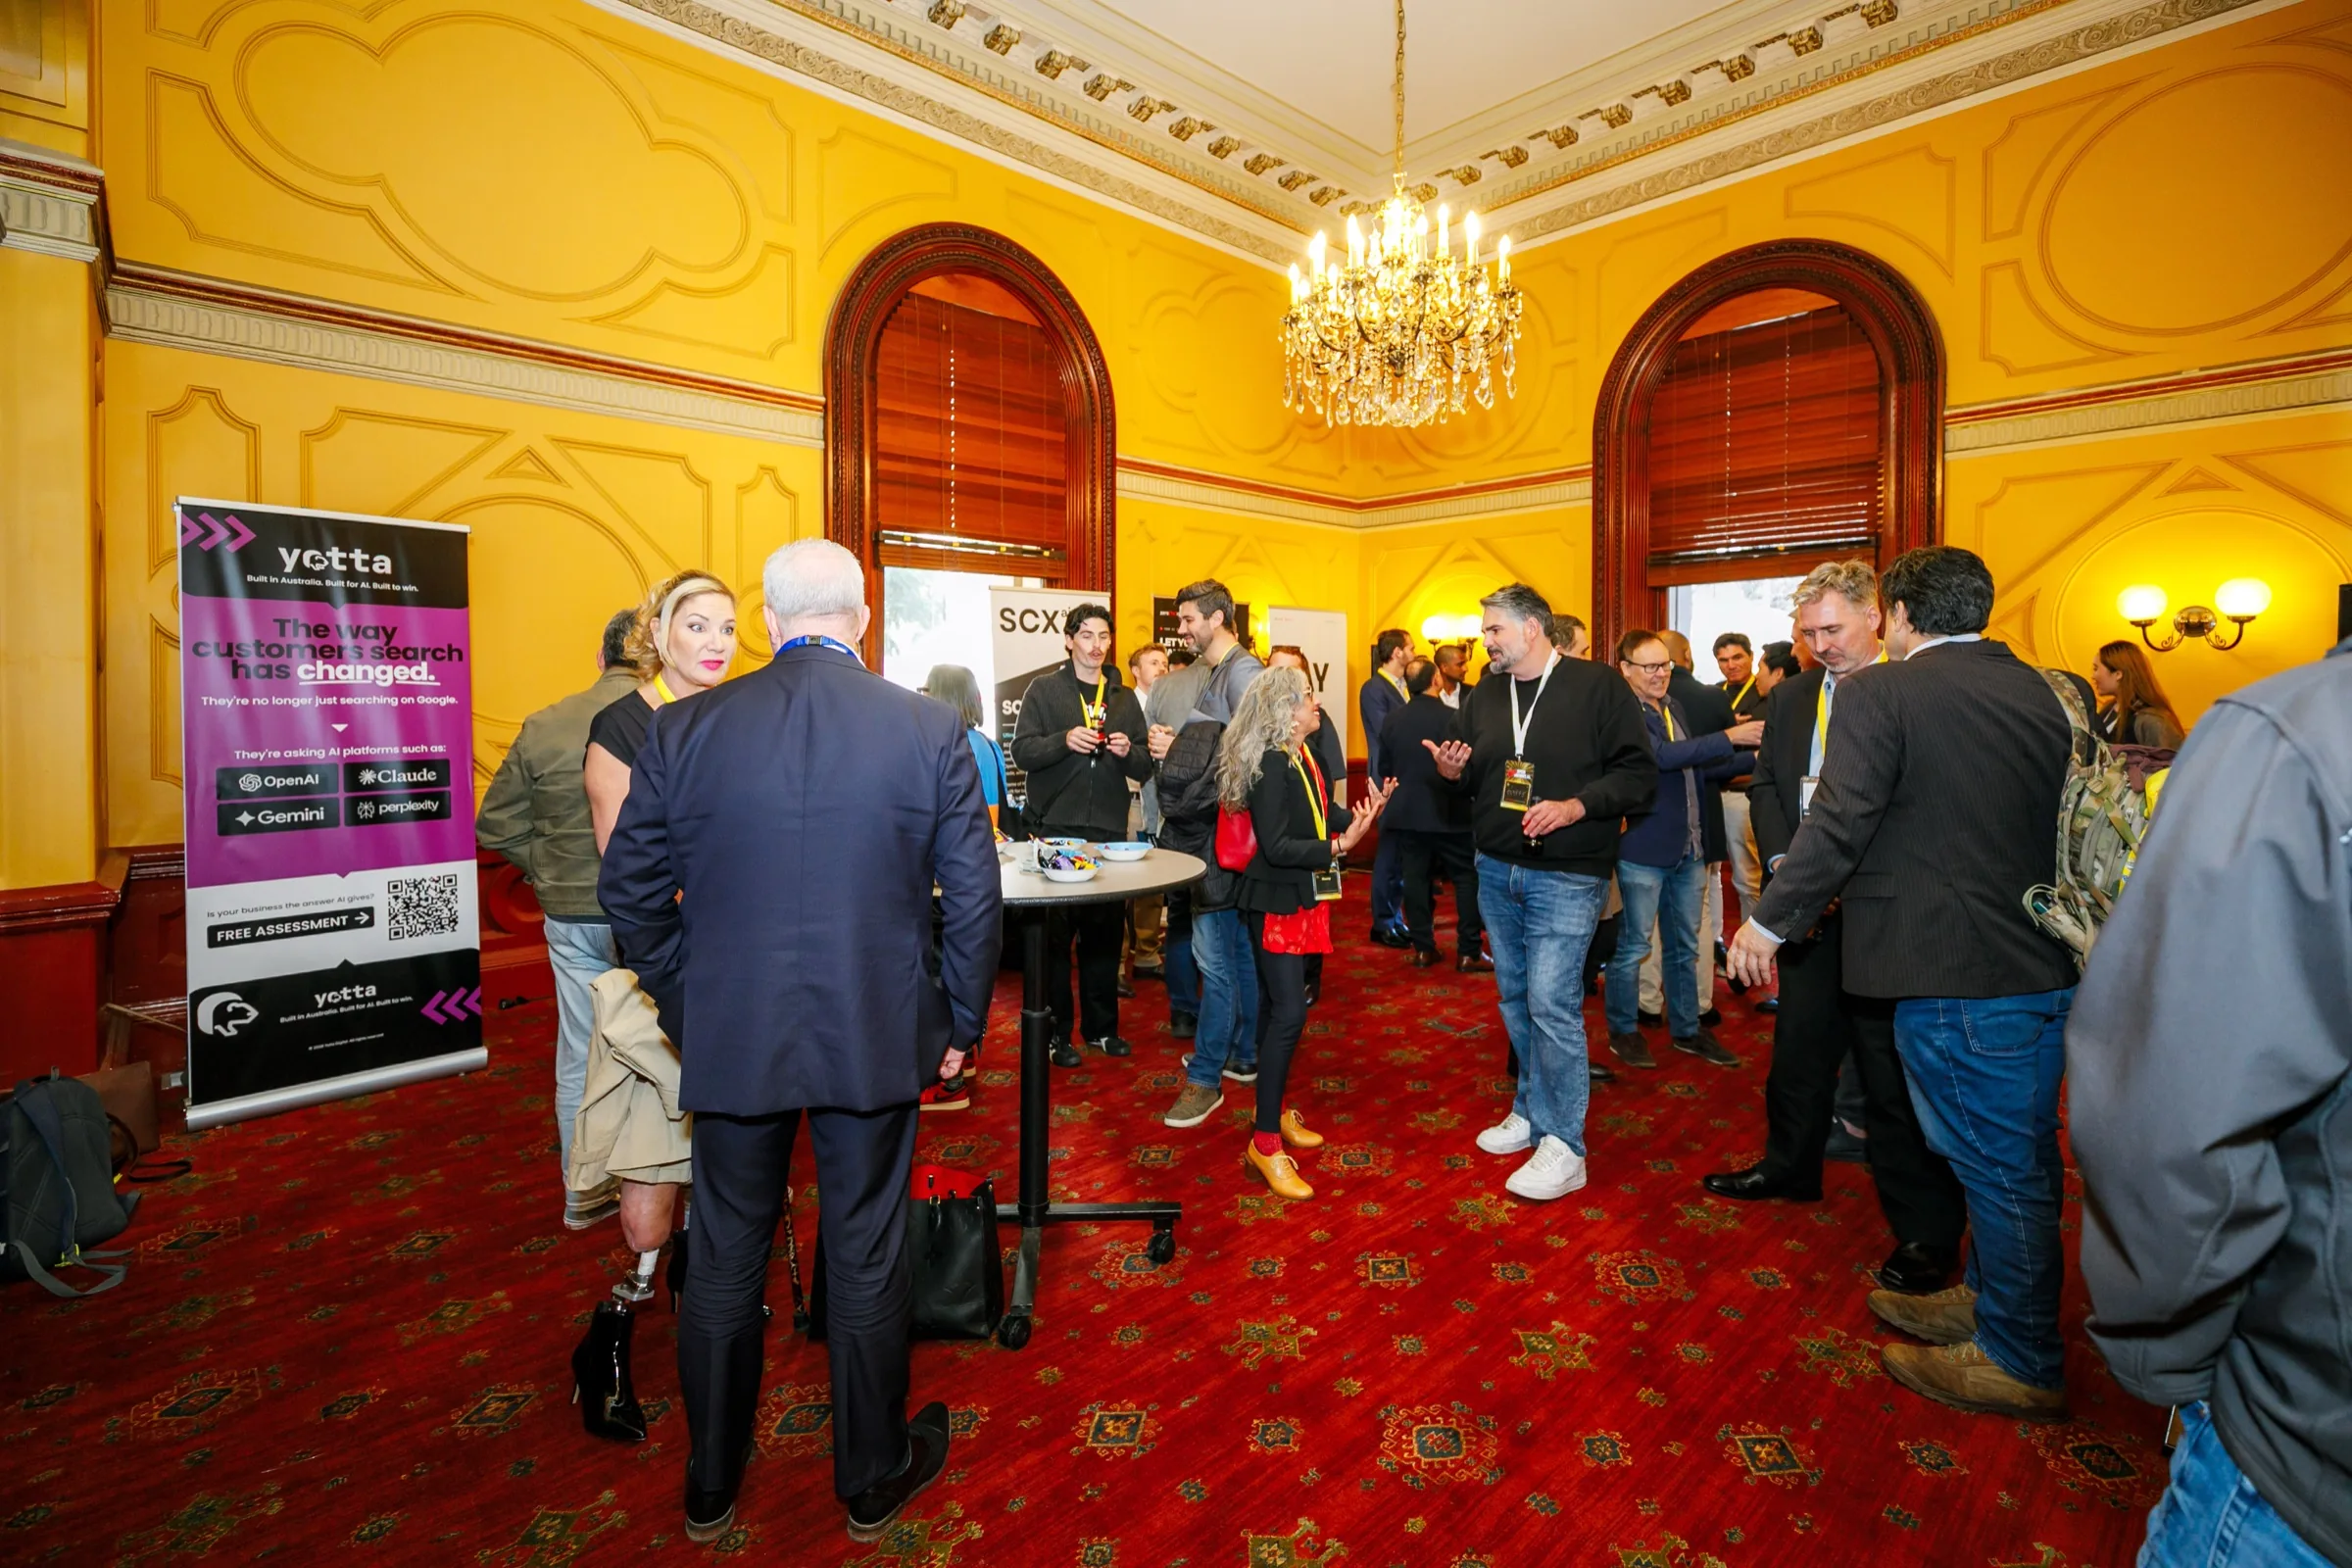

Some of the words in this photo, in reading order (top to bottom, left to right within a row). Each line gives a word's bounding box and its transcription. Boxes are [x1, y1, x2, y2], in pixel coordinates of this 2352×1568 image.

[277, 546, 392, 574] yotta
[246, 574, 268, 583] Built
[280, 576, 323, 586] Australia.
[1000, 607, 1059, 634] SCX
[272, 618, 330, 639] The
[335, 624, 398, 646] way
[192, 639, 364, 660] customers
[370, 643, 464, 662] search
[231, 660, 291, 679] has
[297, 660, 436, 686] changed.
[201, 695, 249, 708] They're
[252, 697, 270, 706] no
[271, 695, 313, 708] longer
[315, 695, 337, 708] just
[339, 695, 399, 707] searching
[416, 695, 459, 707] Google.
[234, 748, 280, 761] They're
[283, 748, 325, 759] asking
[328, 747, 340, 756] AI
[343, 746, 399, 758] platforms
[264, 773, 319, 789] OpenAI
[377, 767, 437, 783] Claude
[258, 807, 324, 824] Gemini
[378, 800, 439, 815] perplexity
[217, 908, 239, 918] your
[241, 904, 283, 913] business
[302, 898, 334, 907] answer
[347, 893, 374, 904] gives?
[217, 927, 252, 942] FREE
[255, 915, 349, 937] ASSESSMENT
[314, 984, 376, 1008] yotta
[339, 1004, 355, 1013] Built
